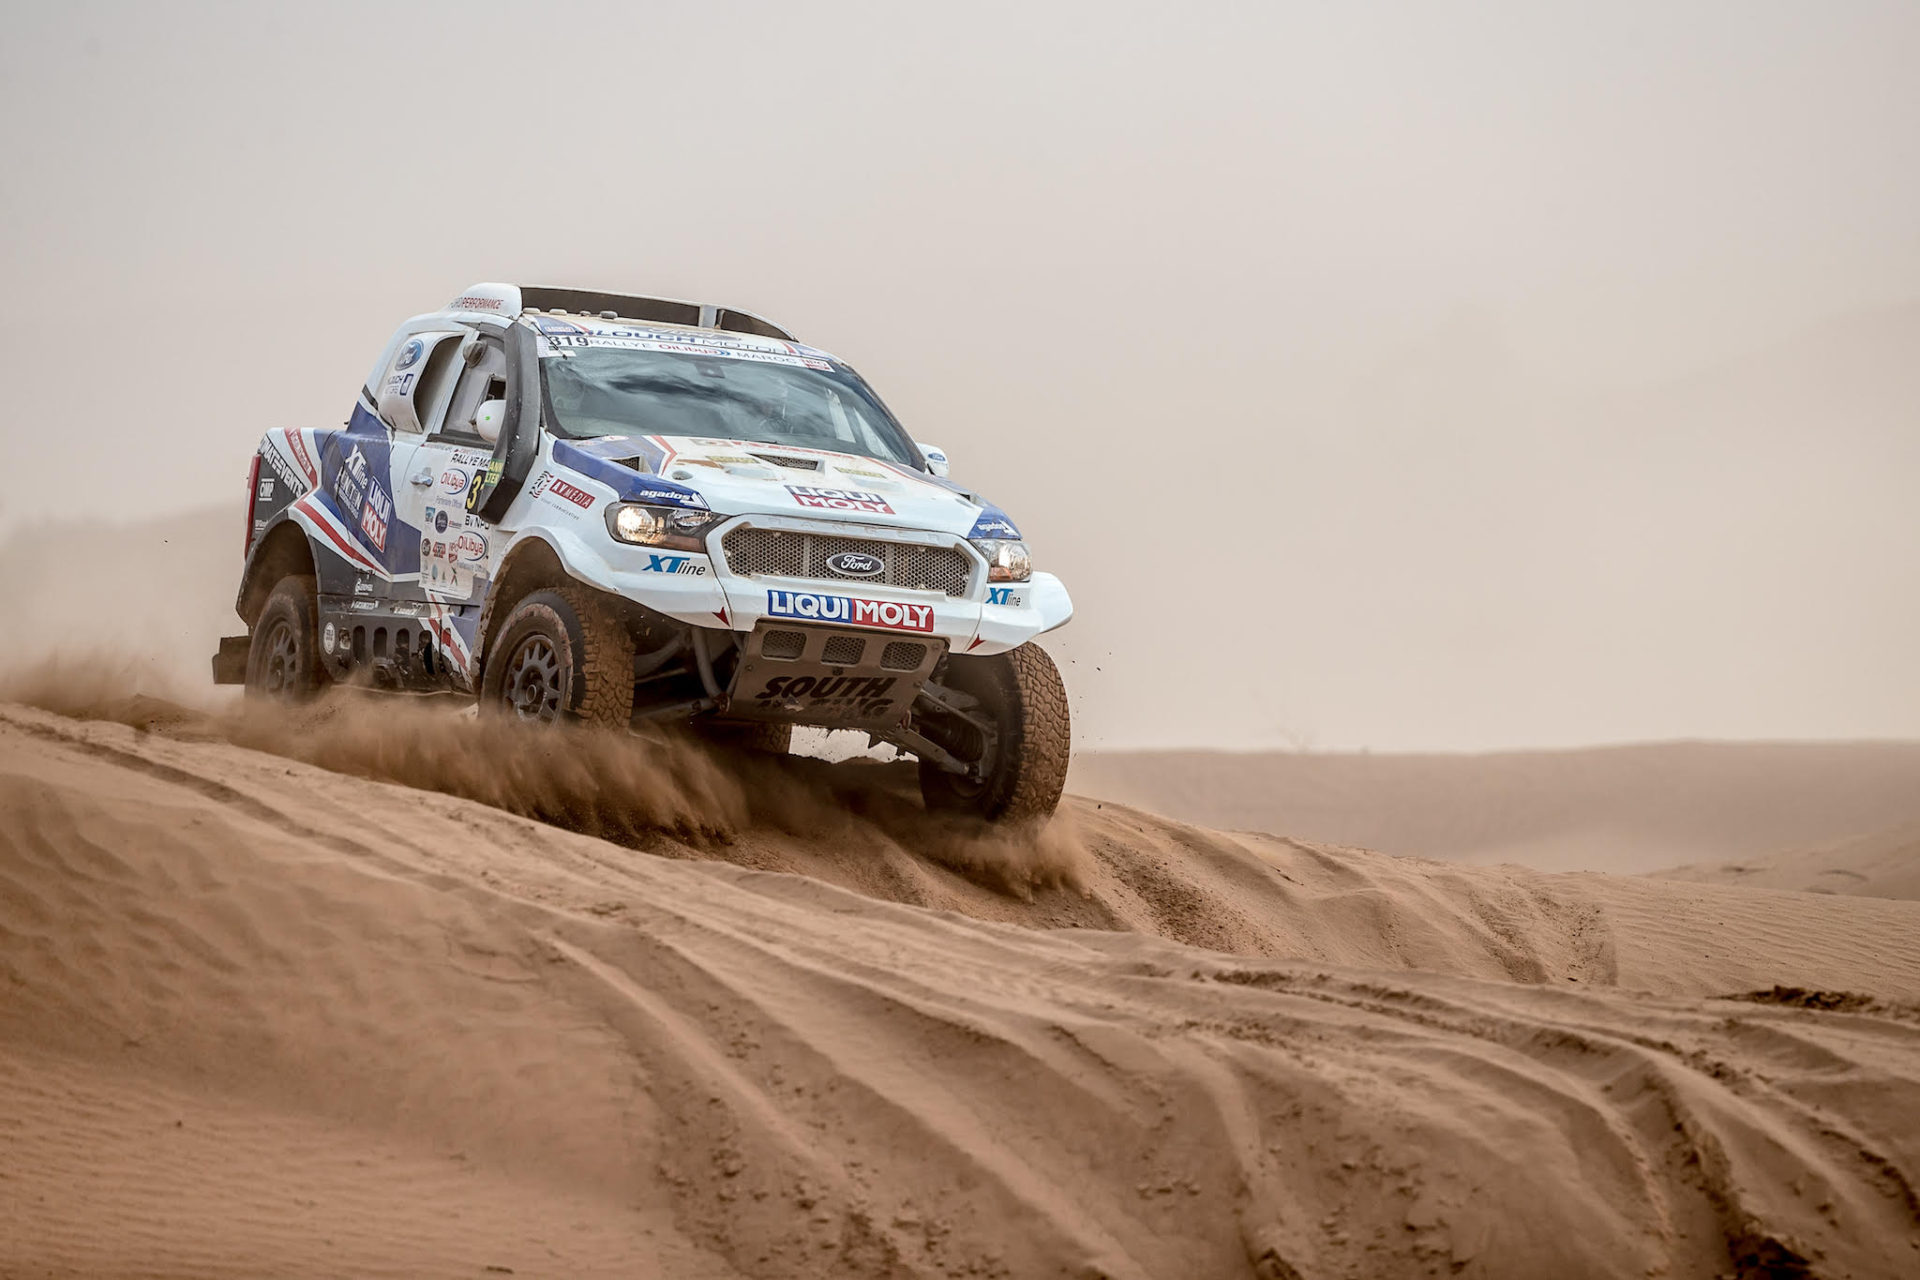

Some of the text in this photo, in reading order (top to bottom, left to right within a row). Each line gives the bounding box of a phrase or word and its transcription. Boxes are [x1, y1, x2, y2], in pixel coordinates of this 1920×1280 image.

[549, 336, 589, 347] 319
[451, 453, 480, 467] RALLYE
[369, 481, 391, 523] LIQUI
[551, 481, 592, 508] AVMEDIA
[640, 490, 691, 500] agados
[791, 485, 882, 502] LIQUI
[803, 496, 888, 514] MOLY
[363, 505, 386, 550] MOLY
[642, 555, 705, 576] XTline
[840, 554, 873, 572] Ford
[986, 588, 1021, 607] XTline
[771, 591, 931, 628] LIQUI MOLY
[755, 676, 898, 699] SOUTH
